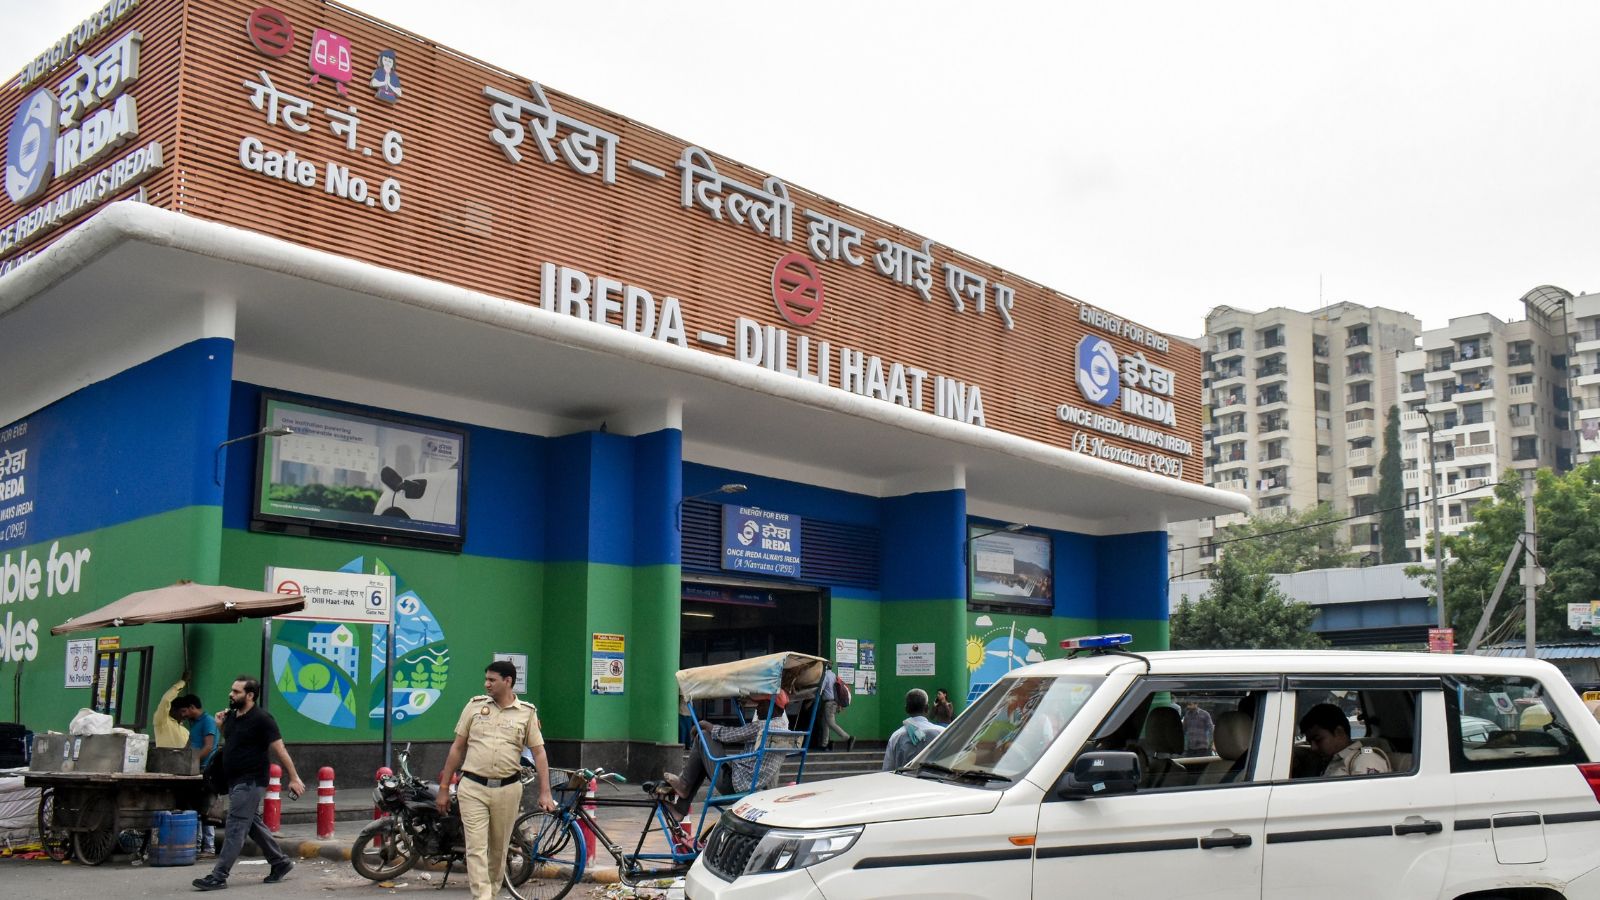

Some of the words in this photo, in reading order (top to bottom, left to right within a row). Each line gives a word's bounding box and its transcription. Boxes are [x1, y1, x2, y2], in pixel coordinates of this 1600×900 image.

[20, 33, 71, 89] ENERGY
[70, 12, 100, 53] FOR
[60, 30, 143, 128] इरेडा
[243, 70, 313, 132] गेट
[382, 130, 403, 165] 6
[55, 94, 138, 181] IREDA
[15, 201, 53, 243] IREDA
[53, 169, 108, 221] ALWAYS
[110, 141, 163, 191] IREDA
[240, 137, 316, 187] Gate
[325, 162, 375, 208] No.
[380, 178, 402, 213] 6
[482, 80, 620, 185] इरेडा
[675, 145, 794, 243] दिल्ली
[804, 208, 866, 267] हाट
[874, 239, 934, 302] आई
[942, 262, 987, 315] एन
[992, 282, 1014, 331] ए
[540, 262, 688, 348] IREDA
[735, 317, 830, 388] DILLI
[839, 347, 928, 411] HAAT
[934, 375, 985, 427] INA
[1080, 305, 1122, 334] ENERGY
[1123, 322, 1144, 343] FOR
[1146, 333, 1169, 353] EVER
[1120, 351, 1175, 396] इरेडा
[1121, 387, 1177, 427] IREDA
[12, 423, 28, 438] EVER
[1057, 404, 1092, 426] ONCE
[1093, 415, 1125, 438] IREDA
[1128, 425, 1163, 448] ALWAYS
[1165, 435, 1193, 456] IREDA
[1090, 437, 1146, 467] Navratna
[0, 475, 25, 501] REDA
[0, 505, 15, 521] WAYS
[15, 501, 33, 516] IREDA
[740, 507, 762, 517] ENERGY
[763, 511, 775, 519] FOR
[775, 513, 789, 521] EVER
[762, 523, 791, 539] इरेडा
[762, 538, 791, 552] IREDA
[47, 541, 91, 598] for
[726, 548, 744, 556] ONCE
[763, 552, 783, 562] ALWAYS
[784, 555, 800, 564] IREDA
[744, 560, 774, 570] Navratna
[303, 585, 321, 594] दिल्ली
[312, 597, 324, 605] Dilli
[371, 590, 382, 606] 6
[69, 674, 75, 682] No
[76, 673, 91, 684] Parking
